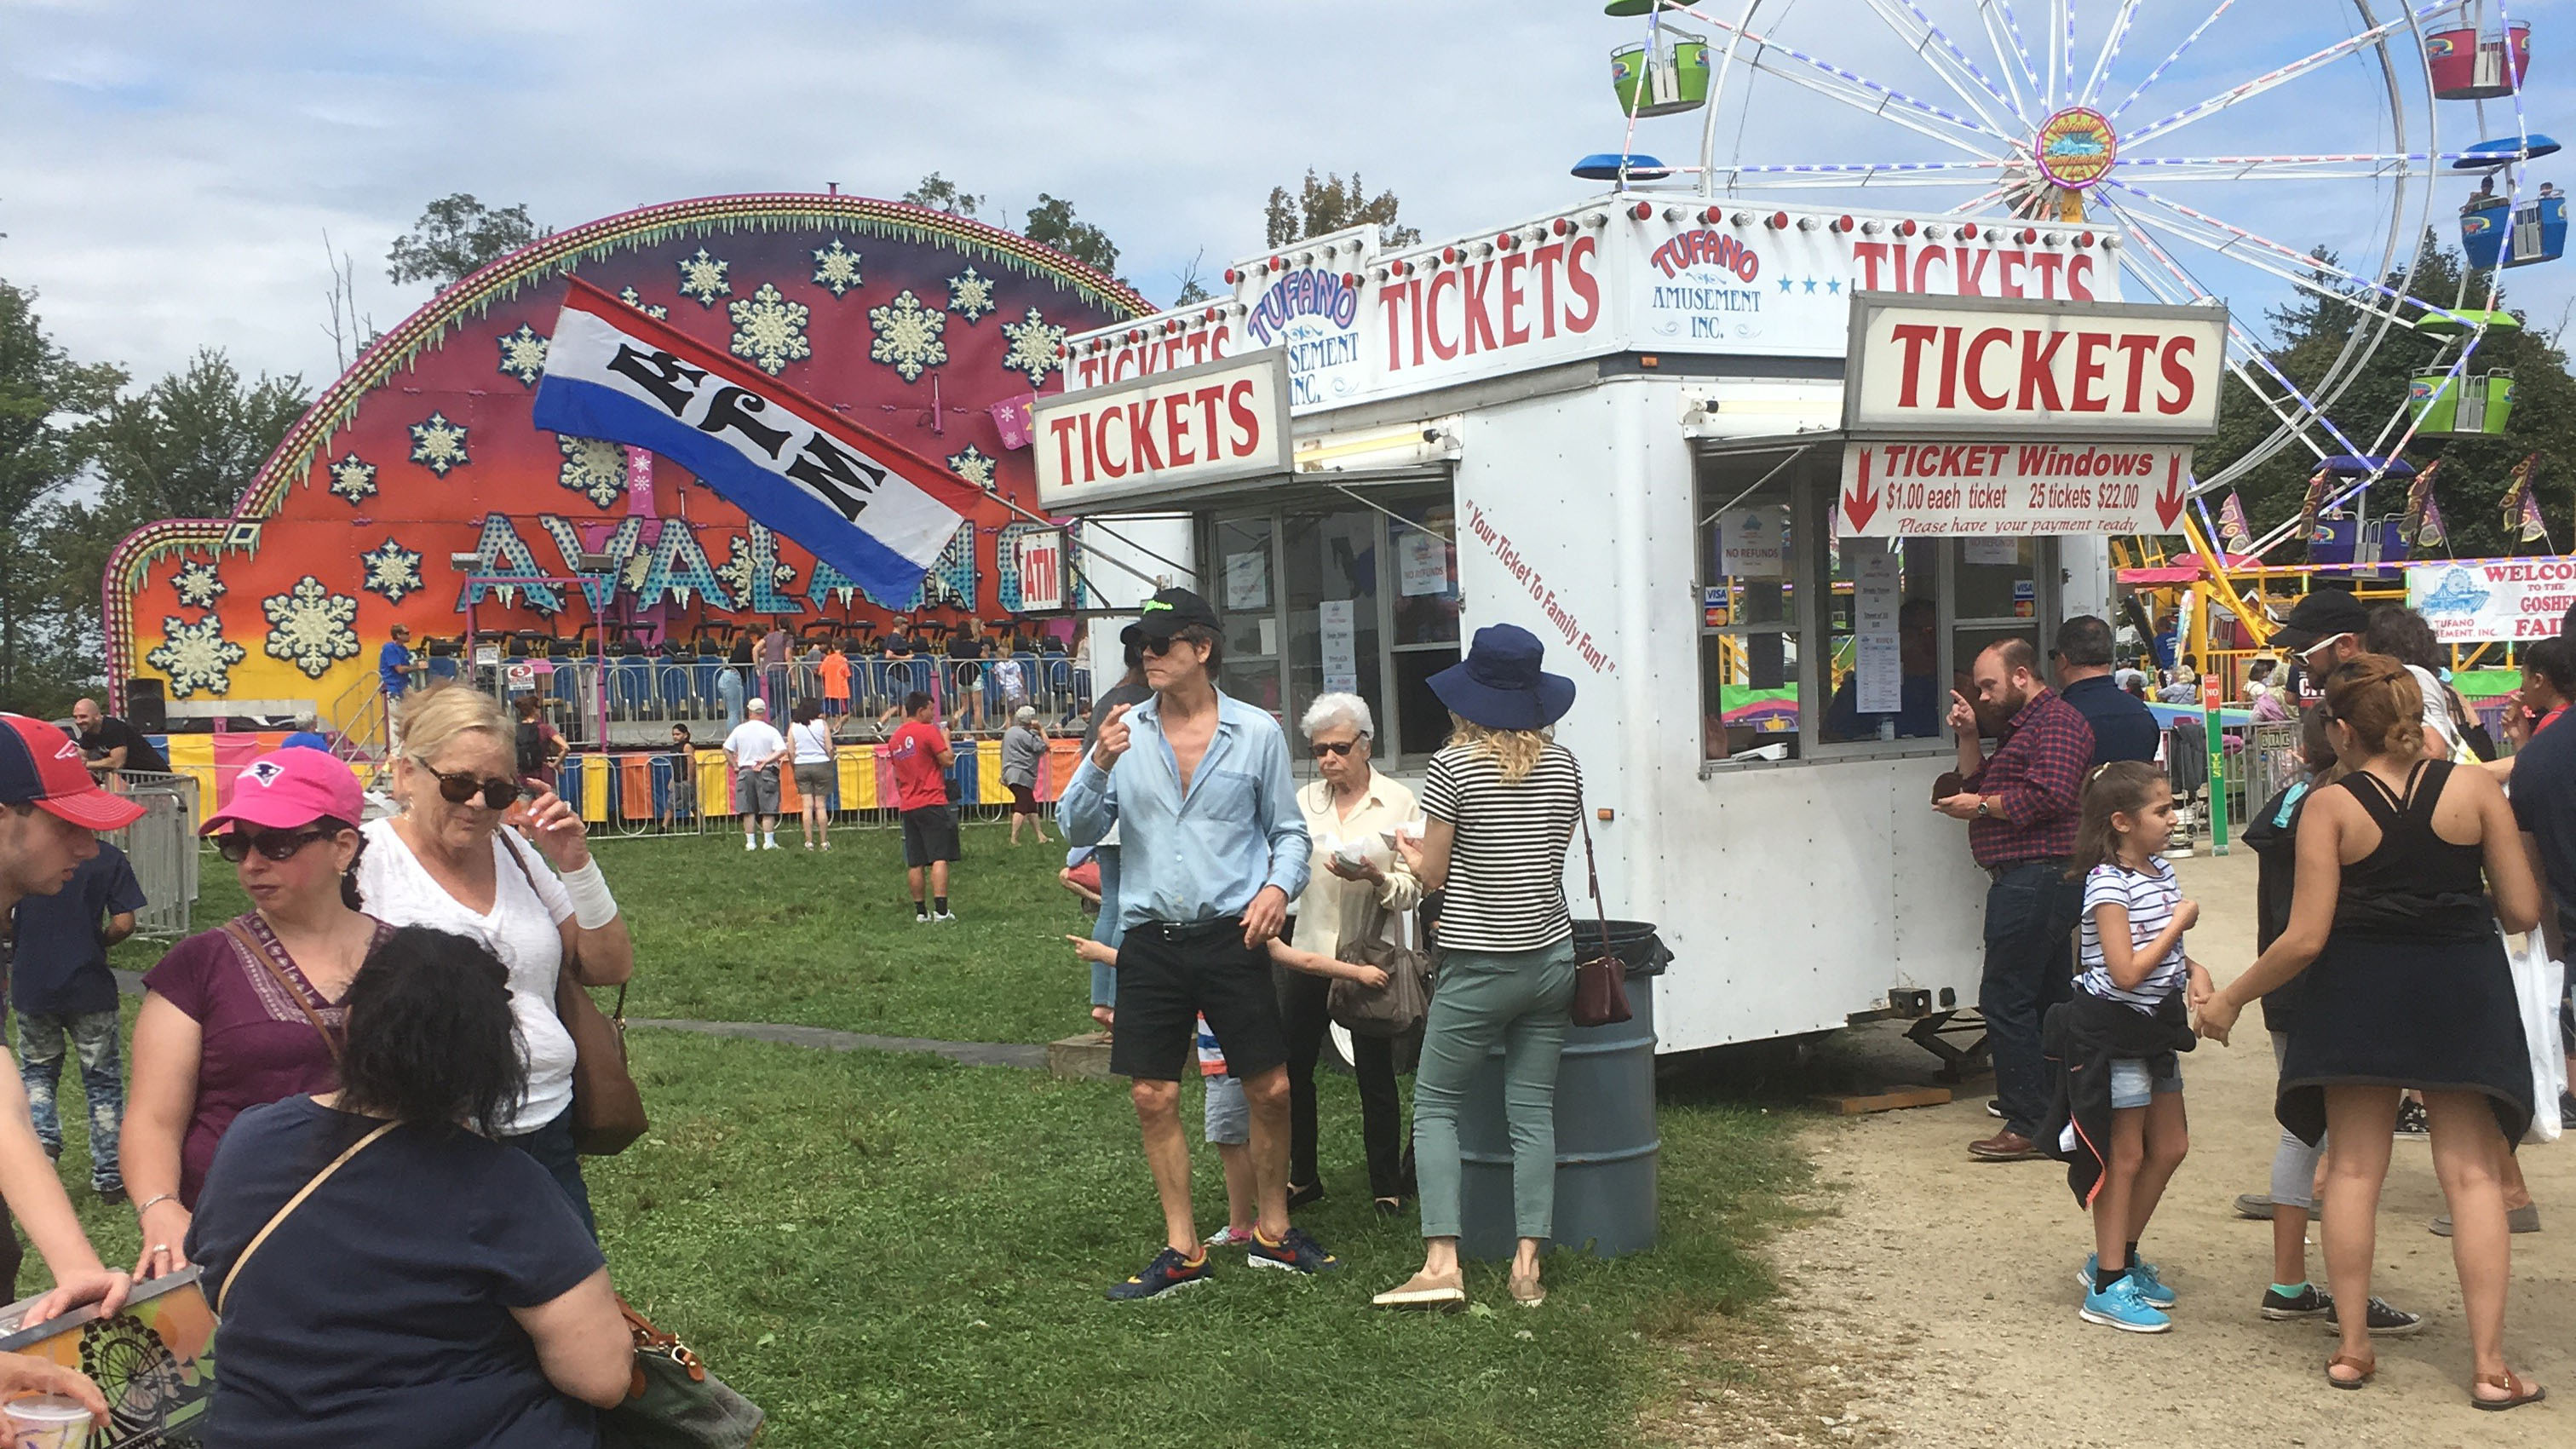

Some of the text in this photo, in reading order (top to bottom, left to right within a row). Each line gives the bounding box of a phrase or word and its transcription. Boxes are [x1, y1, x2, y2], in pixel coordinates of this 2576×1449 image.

[1651, 230, 1759, 283] TUFANO
[1247, 267, 1357, 348] TUFANO
[1378, 236, 1599, 371] TICKETS
[1652, 286, 1761, 313] AMUSEMENT
[1692, 317, 1723, 339] INC.
[1288, 333, 1359, 374] SEMENT
[1891, 324, 2195, 415] TICKETS
[1050, 380, 1259, 486] TICKETS
[1883, 446, 2153, 477] TICKET Windows
[1886, 481, 2139, 512] $1.00 each ticket 25 tickets $22.00
[1898, 515, 2138, 535] Please have your payment ready
[1726, 548, 1779, 558] NO REFUNDS
[1025, 548, 1058, 603] ATM
[2484, 563, 2576, 583] WELCO
[1495, 535, 1532, 586] Ticket
[1529, 573, 1544, 601] To
[1541, 590, 1580, 646] Family
[1707, 589, 1727, 599] VISA
[2016, 583, 2033, 592] VISA
[2544, 583, 2566, 591] THE
[2435, 618, 2475, 628] TUFANO
[2435, 629, 2475, 638] SEMENT,
[2515, 618, 2565, 637] FAI
[2206, 688, 2219, 697] NO
[2211, 752, 2222, 778] YES
